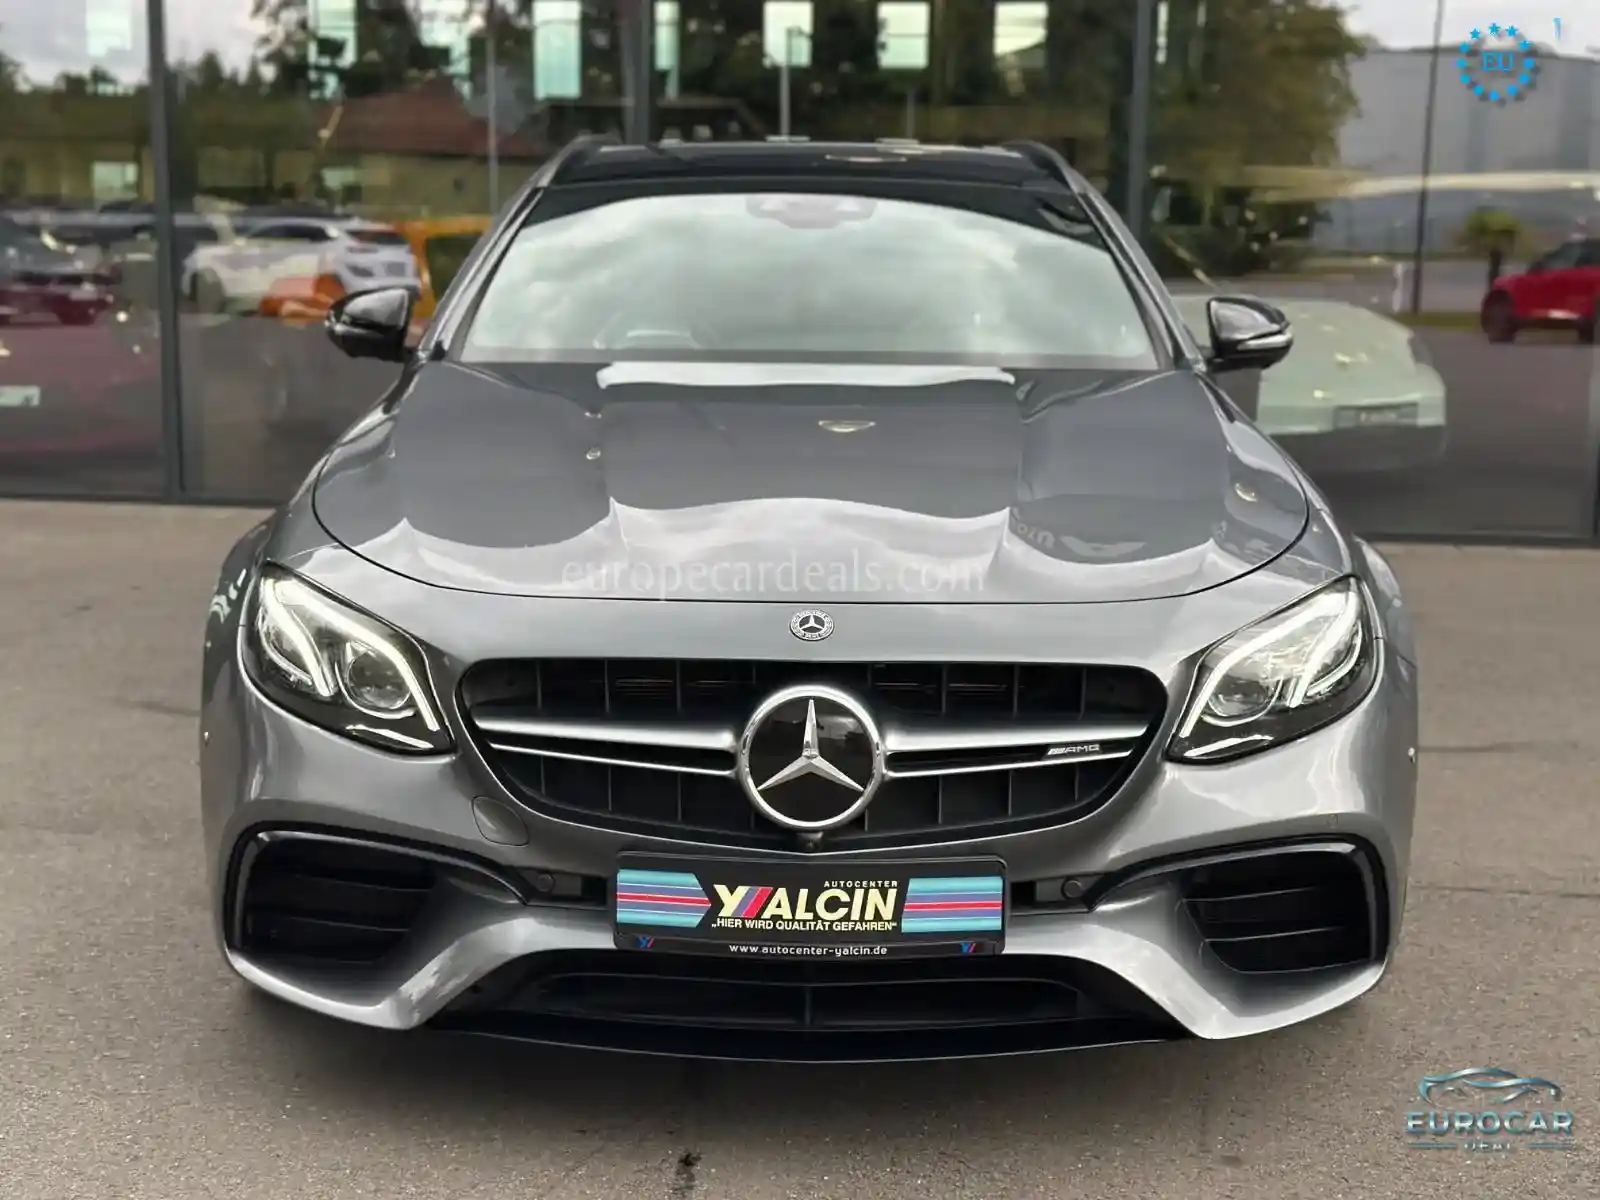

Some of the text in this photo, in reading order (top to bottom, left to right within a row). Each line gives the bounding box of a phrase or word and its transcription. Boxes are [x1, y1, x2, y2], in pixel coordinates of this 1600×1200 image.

[1064, 744, 1100, 753] AMG
[823, 880, 898, 888] AUTOCENTER
[744, 919, 774, 930] WIRD
[775, 921, 831, 931] QUALITÄT
[728, 943, 889, 957] www.autocenter-yalcin.de
